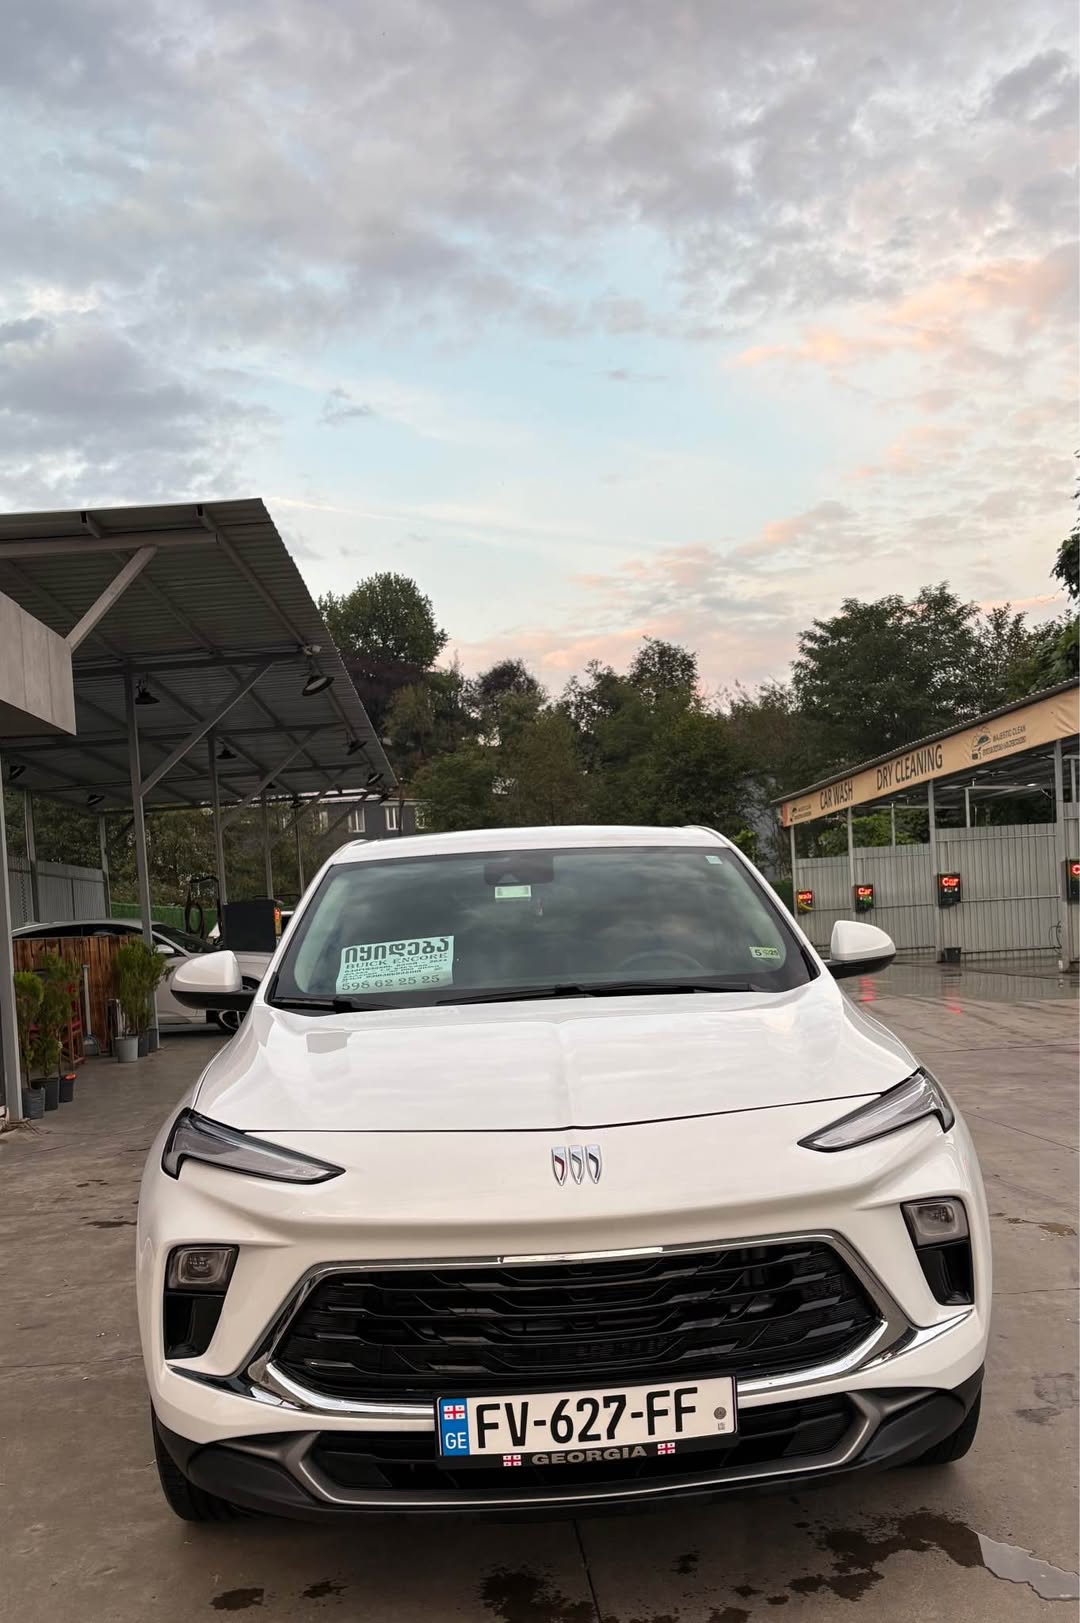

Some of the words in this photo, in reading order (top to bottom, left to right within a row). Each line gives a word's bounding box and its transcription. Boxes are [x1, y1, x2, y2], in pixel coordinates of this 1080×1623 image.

[877, 763, 893, 791] DRY
[895, 744, 943, 784] CLEANING
[820, 788, 833, 811] CAR
[832, 780, 853, 807] WASH
[858, 887, 872, 895] Car
[344, 938, 449, 963] იყიდება
[346, 960, 388, 969] BUICK
[392, 952, 448, 964] ENCORE
[341, 981, 370, 991] 598
[398, 976, 417, 986] 25
[421, 974, 440, 984] 25
[475, 1386, 698, 1449] FV-627-FF
[445, 1432, 467, 1450] GE
[531, 1445, 648, 1466] GEORGIA
